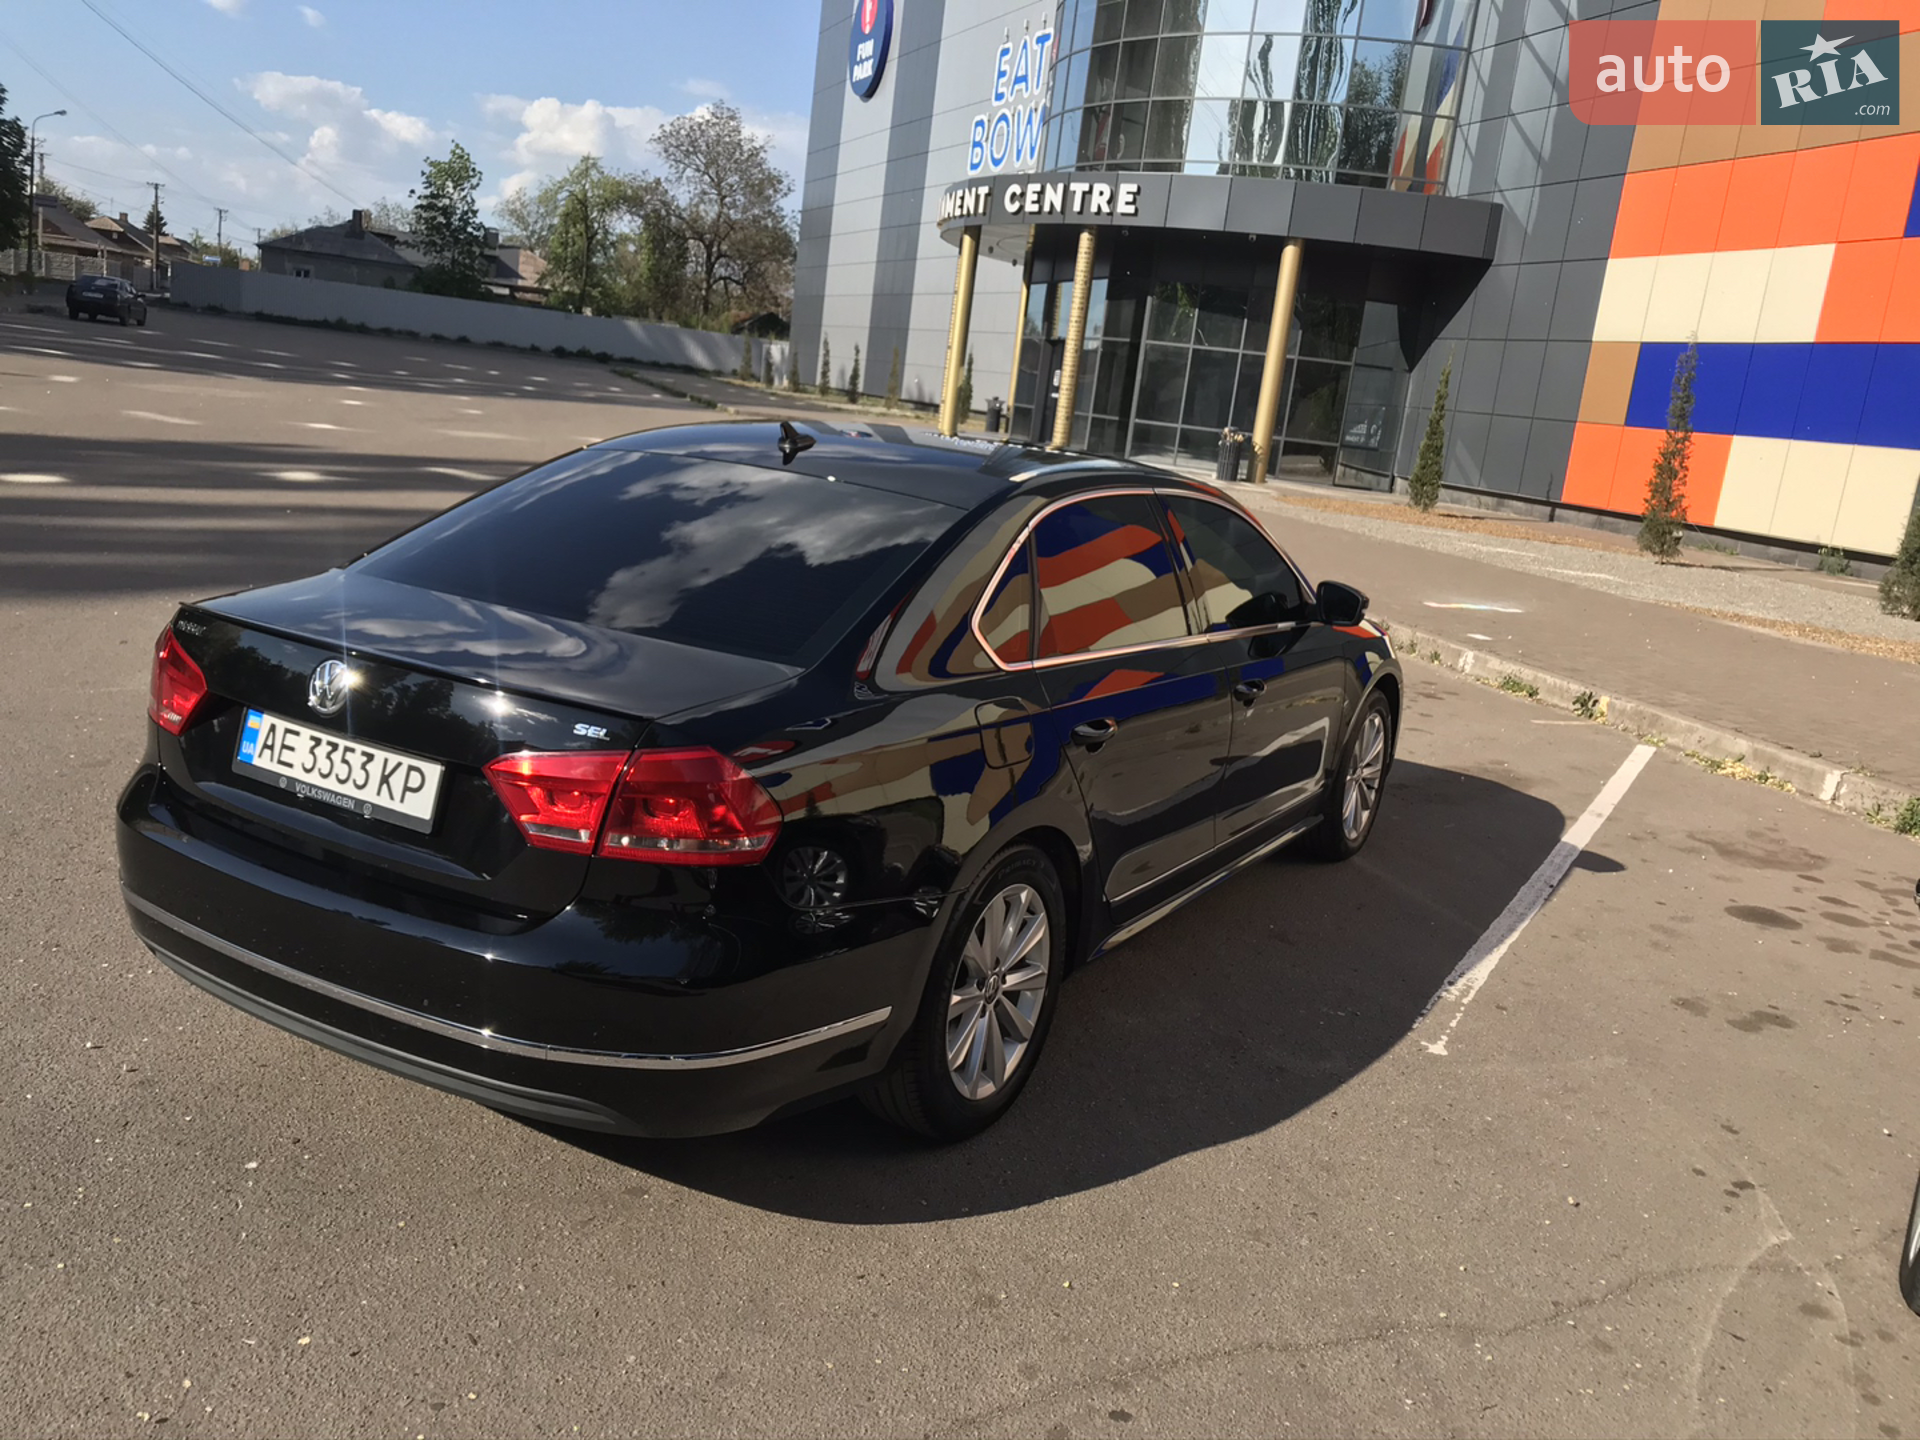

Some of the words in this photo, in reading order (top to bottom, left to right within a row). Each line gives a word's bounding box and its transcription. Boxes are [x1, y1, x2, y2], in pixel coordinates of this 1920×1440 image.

[856, 38, 874, 61] FUN
[852, 58, 874, 82] PARK
[992, 28, 1054, 106] EAT
[967, 98, 1047, 176] BOW
[1003, 181, 1140, 216] CENTRE
[573, 722, 610, 741] SEL
[242, 740, 254, 756] UA
[295, 781, 355, 810] VOLKSWAGEN
